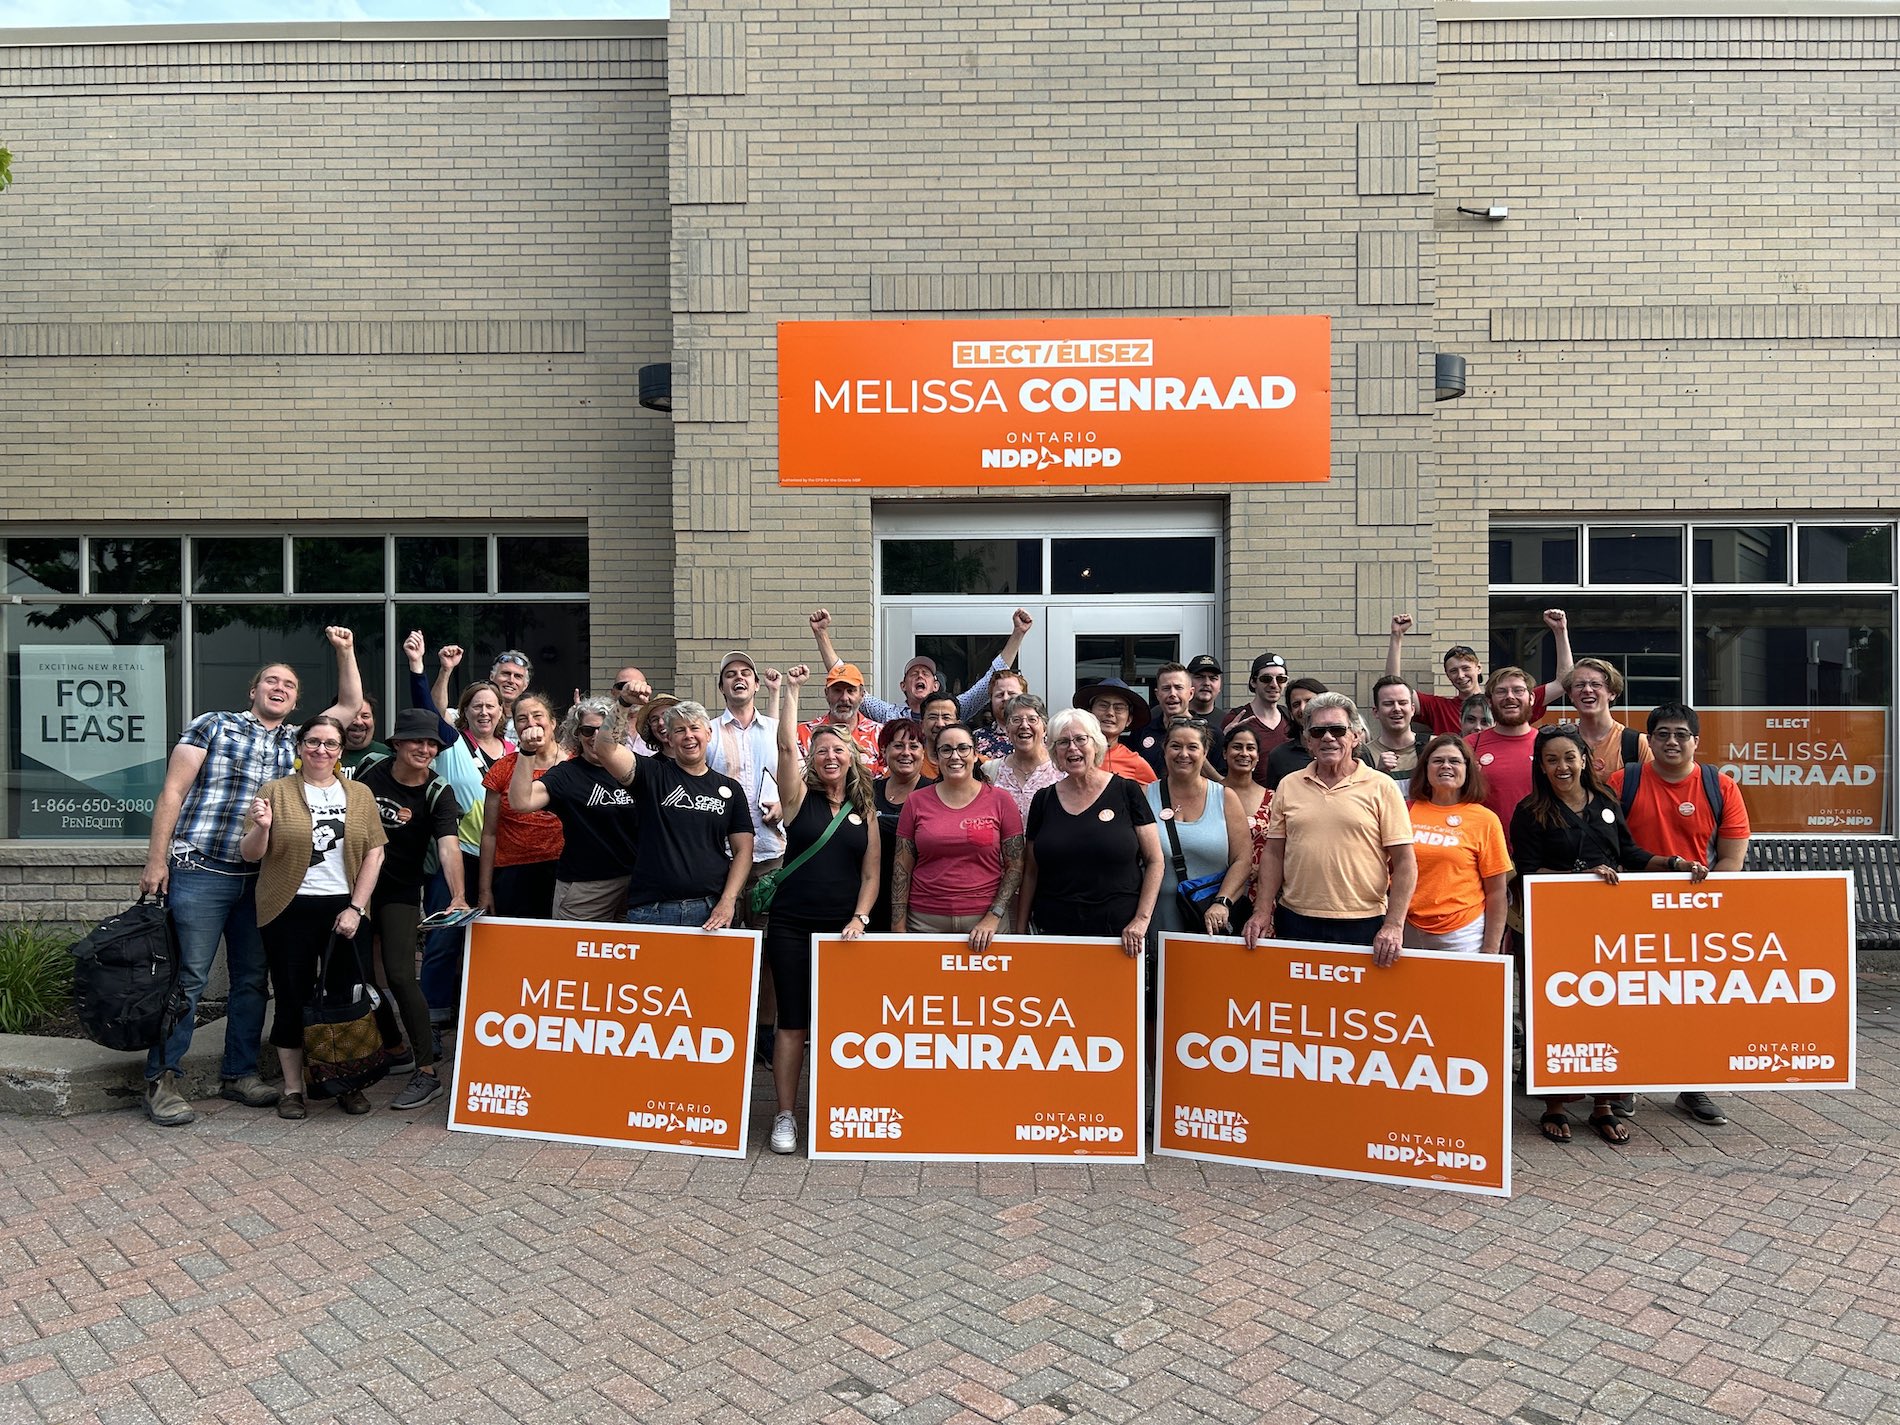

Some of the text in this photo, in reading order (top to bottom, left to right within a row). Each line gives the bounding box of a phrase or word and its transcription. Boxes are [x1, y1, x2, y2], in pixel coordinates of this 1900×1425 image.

[814, 376, 1296, 413] MELISSA COENRAAD
[1007, 432, 1097, 442] ONTARIO
[982, 448, 1121, 468] NDP NPD
[39, 663, 145, 671] EXCITING NEW RETAIL
[57, 679, 128, 708] FOR
[41, 715, 145, 743] LEASE
[1766, 719, 1809, 728] ELECT
[1729, 743, 1847, 760] MELISSA
[1711, 764, 1876, 786] OENRAAD
[31, 798, 155, 813] 1-866-650-3080
[694, 802, 725, 815] SEFPO
[695, 794, 726, 808] OPSEU
[1808, 817, 1872, 825] NDP NPD
[1413, 829, 1460, 847] NDP
[1651, 893, 1722, 909] ELECT
[577, 942, 640, 960] ELECT
[1595, 932, 1787, 963] MELISSA
[941, 955, 1012, 971] ELECT
[1290, 962, 1365, 984] ELECT
[1545, 969, 1836, 1007] COENRAAD
[520, 977, 693, 1018] MELISSA
[882, 995, 1075, 1028] MELISSA
[1228, 999, 1435, 1047] MELISSA
[475, 1011, 735, 1064] COENRAAD
[831, 1032, 1124, 1072] COENRAAD
[1547, 1043, 1606, 1058] MARIT
[1748, 1043, 1816, 1052] ONTARIO
[1176, 1033, 1488, 1096] COENRAAD
[1547, 1058, 1617, 1072] STILES
[1729, 1055, 1835, 1070] NDP NPD
[470, 1082, 520, 1099] MARIT
[467, 1097, 528, 1116] STILES
[647, 1100, 711, 1114] ONTARIO
[830, 1107, 890, 1122] MARIT
[1175, 1106, 1235, 1124] MARIT
[628, 1112, 727, 1134] NDP NPD
[1035, 1112, 1104, 1122] ONTARIO
[830, 1122, 901, 1139] STILES
[1016, 1125, 1123, 1142] NDP NPD
[1174, 1121, 1247, 1144] STILES
[1388, 1132, 1465, 1148] ONTARIO
[1367, 1144, 1487, 1171] NDP NPD
